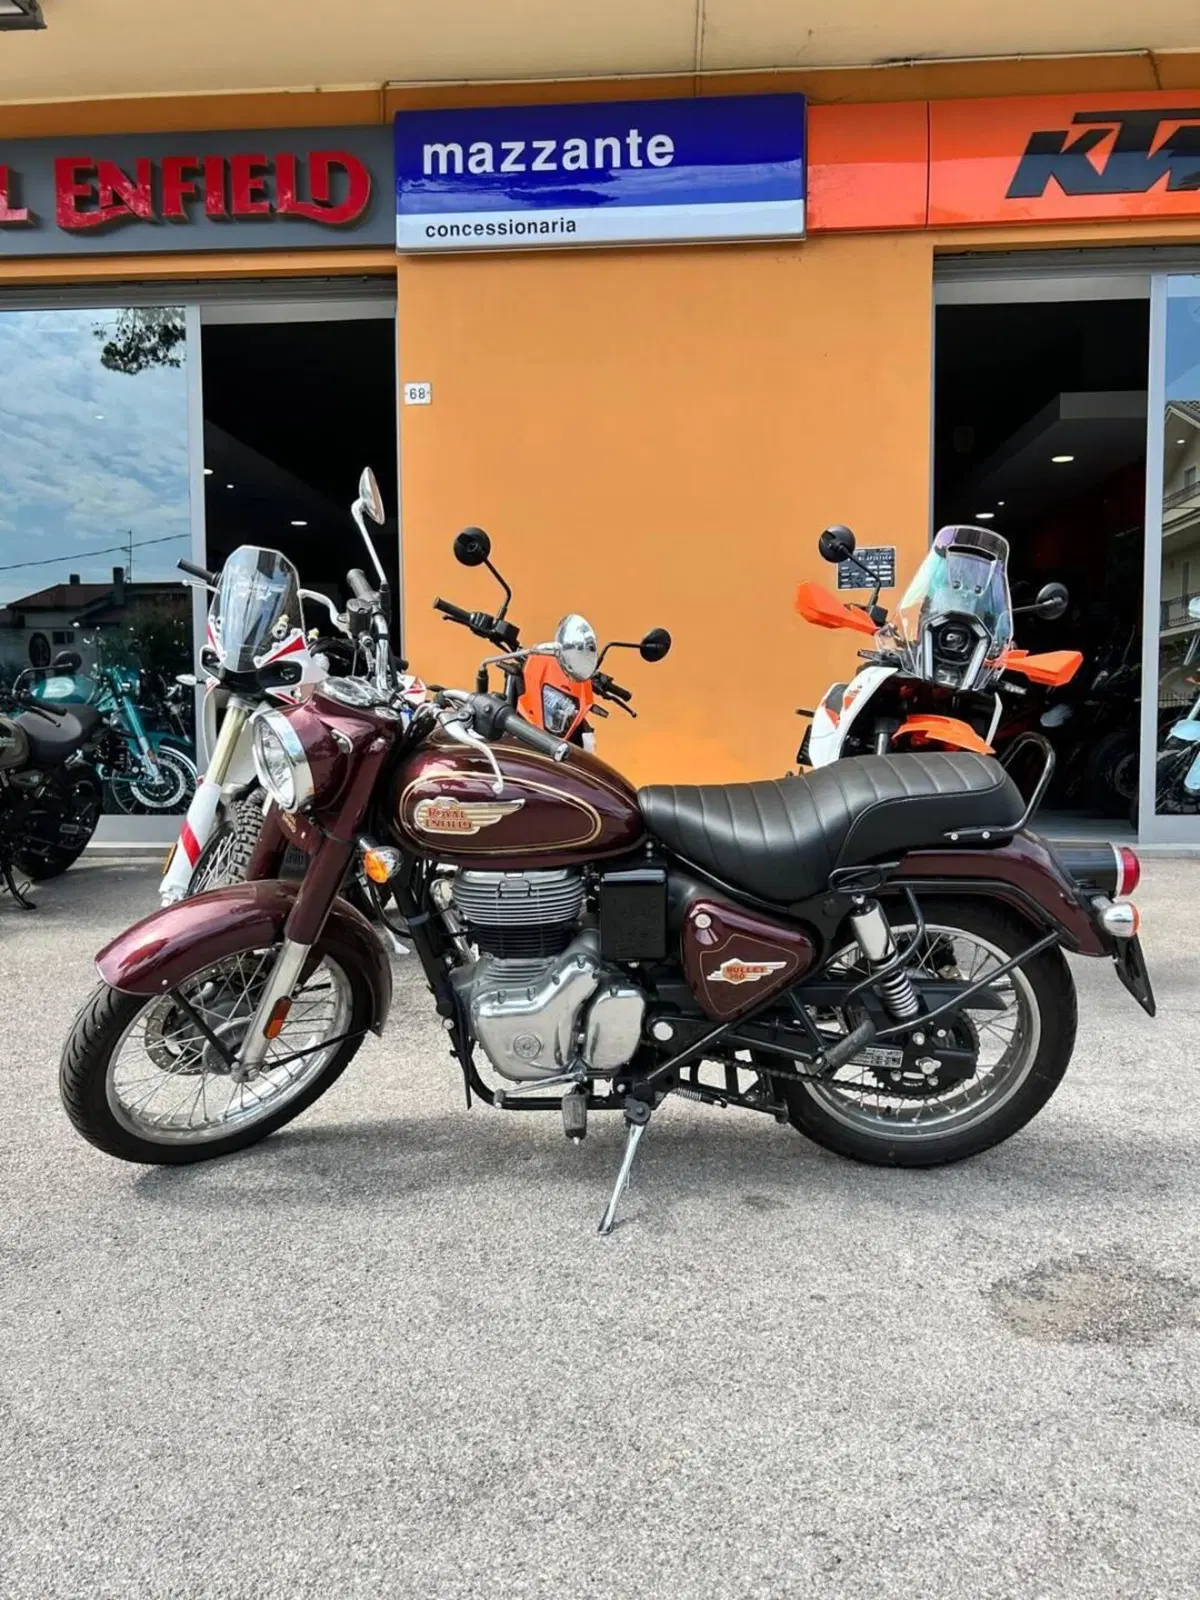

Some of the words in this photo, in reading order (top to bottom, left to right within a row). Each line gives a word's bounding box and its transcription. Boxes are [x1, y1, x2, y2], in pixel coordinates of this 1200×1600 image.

[423, 128, 675, 175] mazzante
[54, 151, 372, 229] ENFIELD
[425, 217, 577, 238] concessionaria
[409, 387, 426, 400] 68
